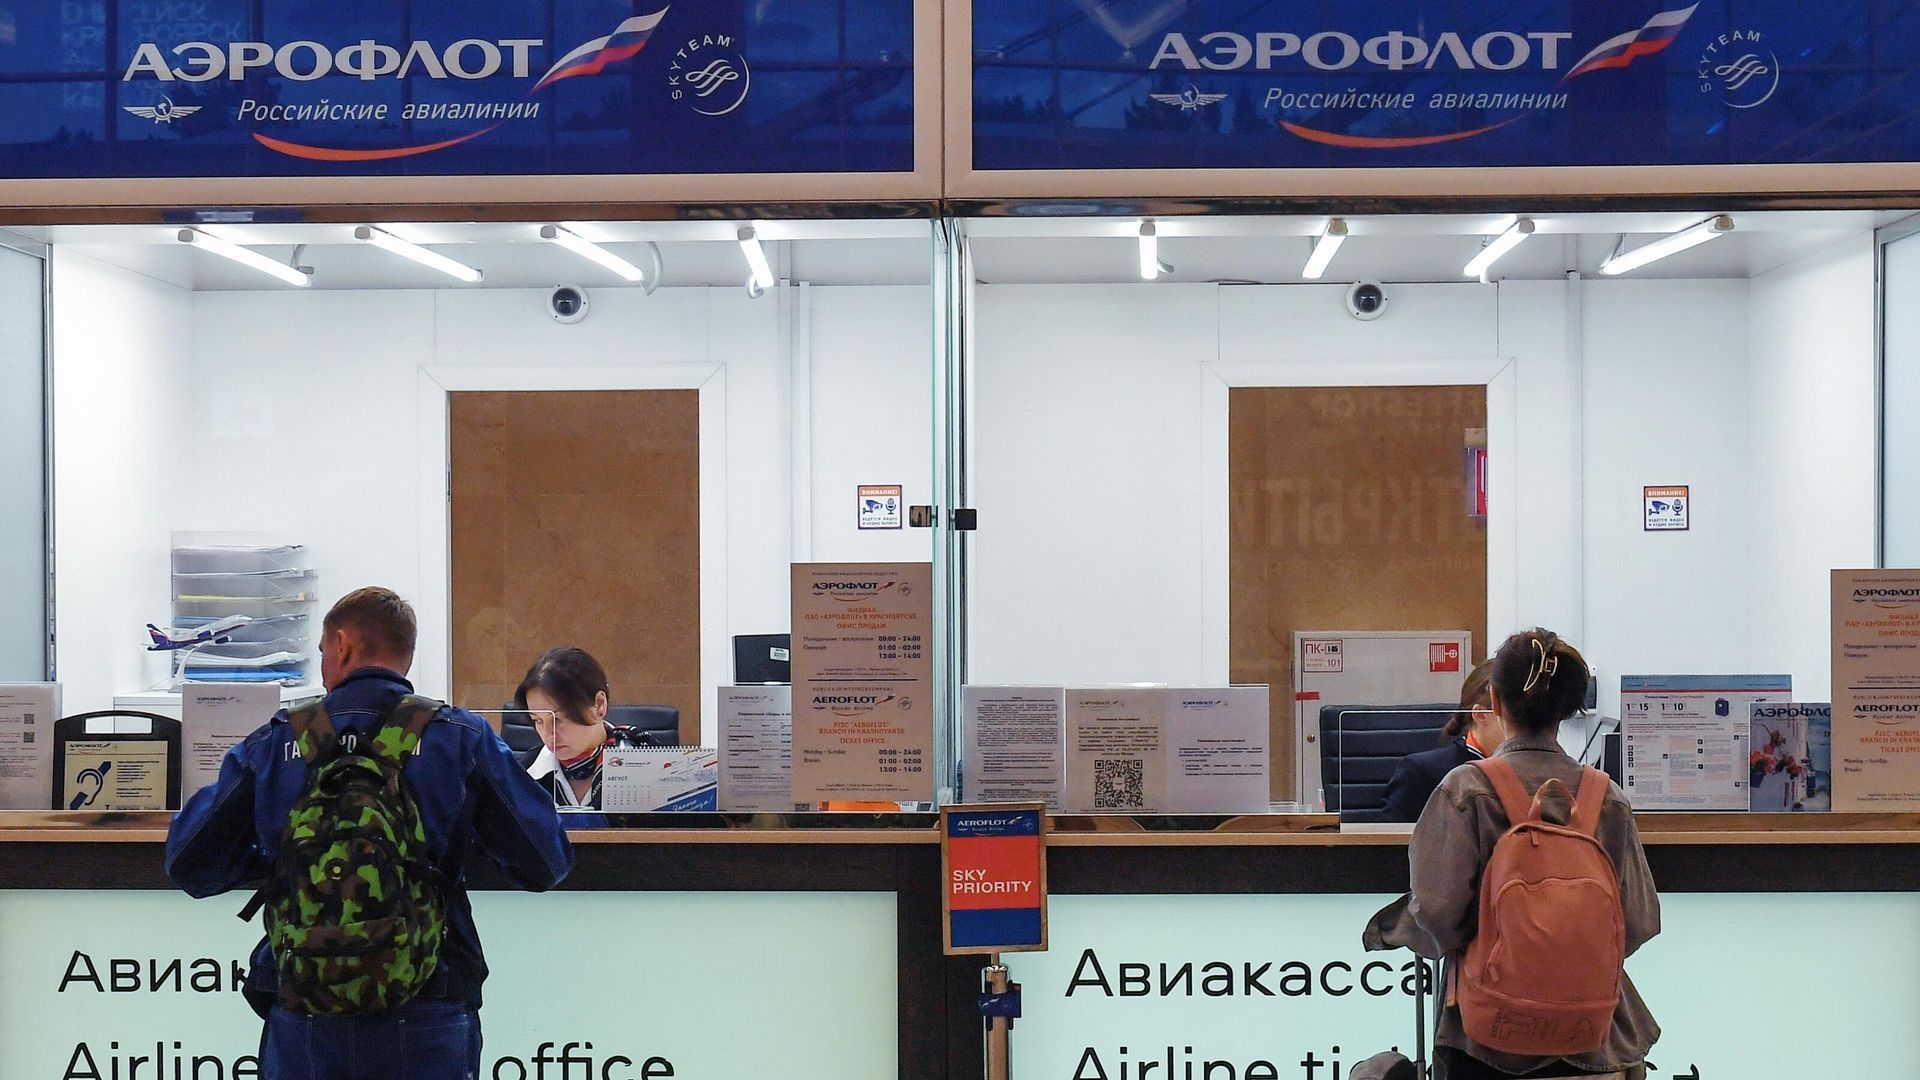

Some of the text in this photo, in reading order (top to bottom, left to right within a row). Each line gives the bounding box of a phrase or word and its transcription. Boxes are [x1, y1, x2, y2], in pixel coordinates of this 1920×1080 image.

[122, 39, 543, 82] АЭРОФЛОТ
[1149, 31, 1572, 70] АЭРОФЛОТ
[1698, 30, 1760, 93] SKYTEAM
[669, 34, 731, 100] SKYTEAM
[1264, 87, 1568, 109] Российские авиалинии
[237, 98, 540, 121] Российские авиалинии
[812, 582, 879, 590] АЭРОФЛОТ
[1327, 658, 1341, 667] 101
[812, 696, 877, 704] AEROFLOT
[1639, 703, 1649, 711] 15
[1673, 703, 1684, 711] 10
[1853, 704, 1920, 712] AEROFLOT
[1753, 708, 1832, 717] АЭРОФЛО
[957, 819, 1007, 827] AEROFLOT
[952, 868, 987, 882] SKY
[953, 880, 1033, 894] PRIORITY
[58, 949, 248, 993] Авиак
[1064, 947, 1433, 997] Авиакасса
[62, 1041, 261, 1080] Airline
[491, 1041, 675, 1080] office
[1071, 1046, 1279, 1080] Airline
